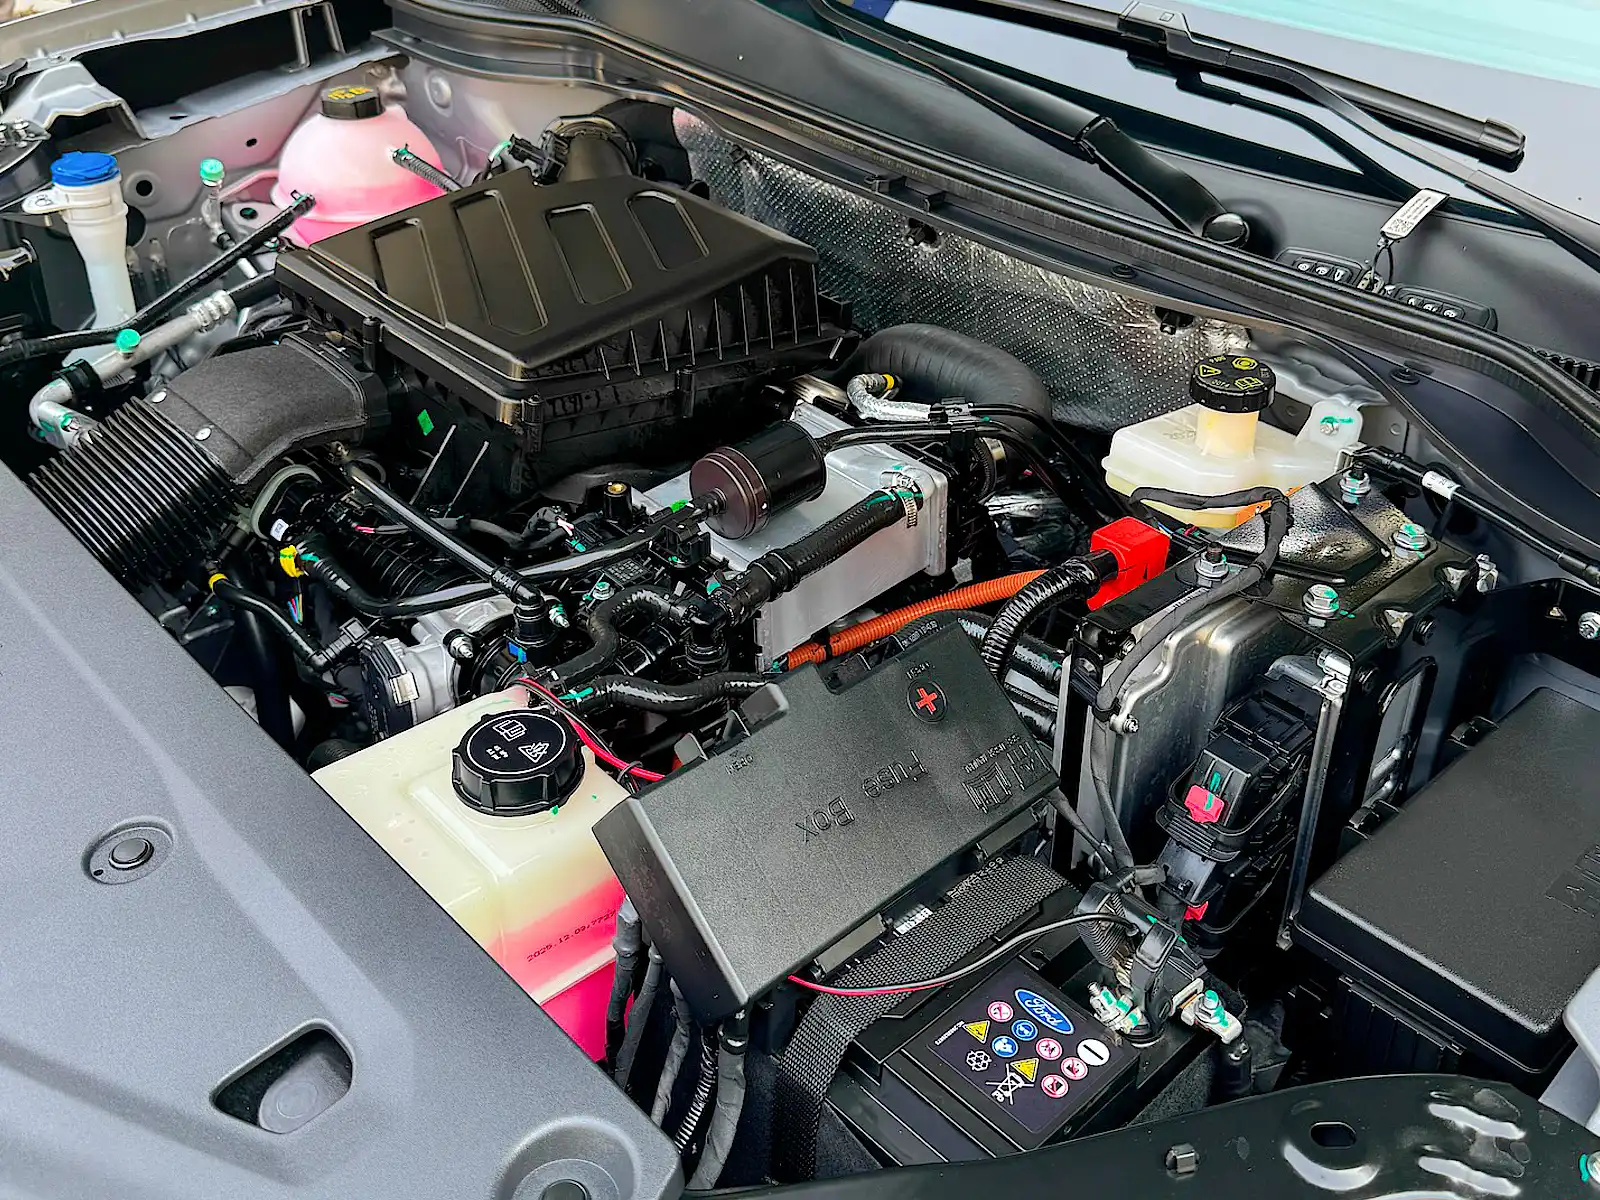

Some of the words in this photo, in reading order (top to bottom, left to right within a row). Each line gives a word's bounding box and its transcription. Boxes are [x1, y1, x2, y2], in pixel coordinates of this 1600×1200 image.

[861, 749, 929, 800] Fuse
[794, 795, 857, 844] Box
[1024, 997, 1064, 1026] Ford
